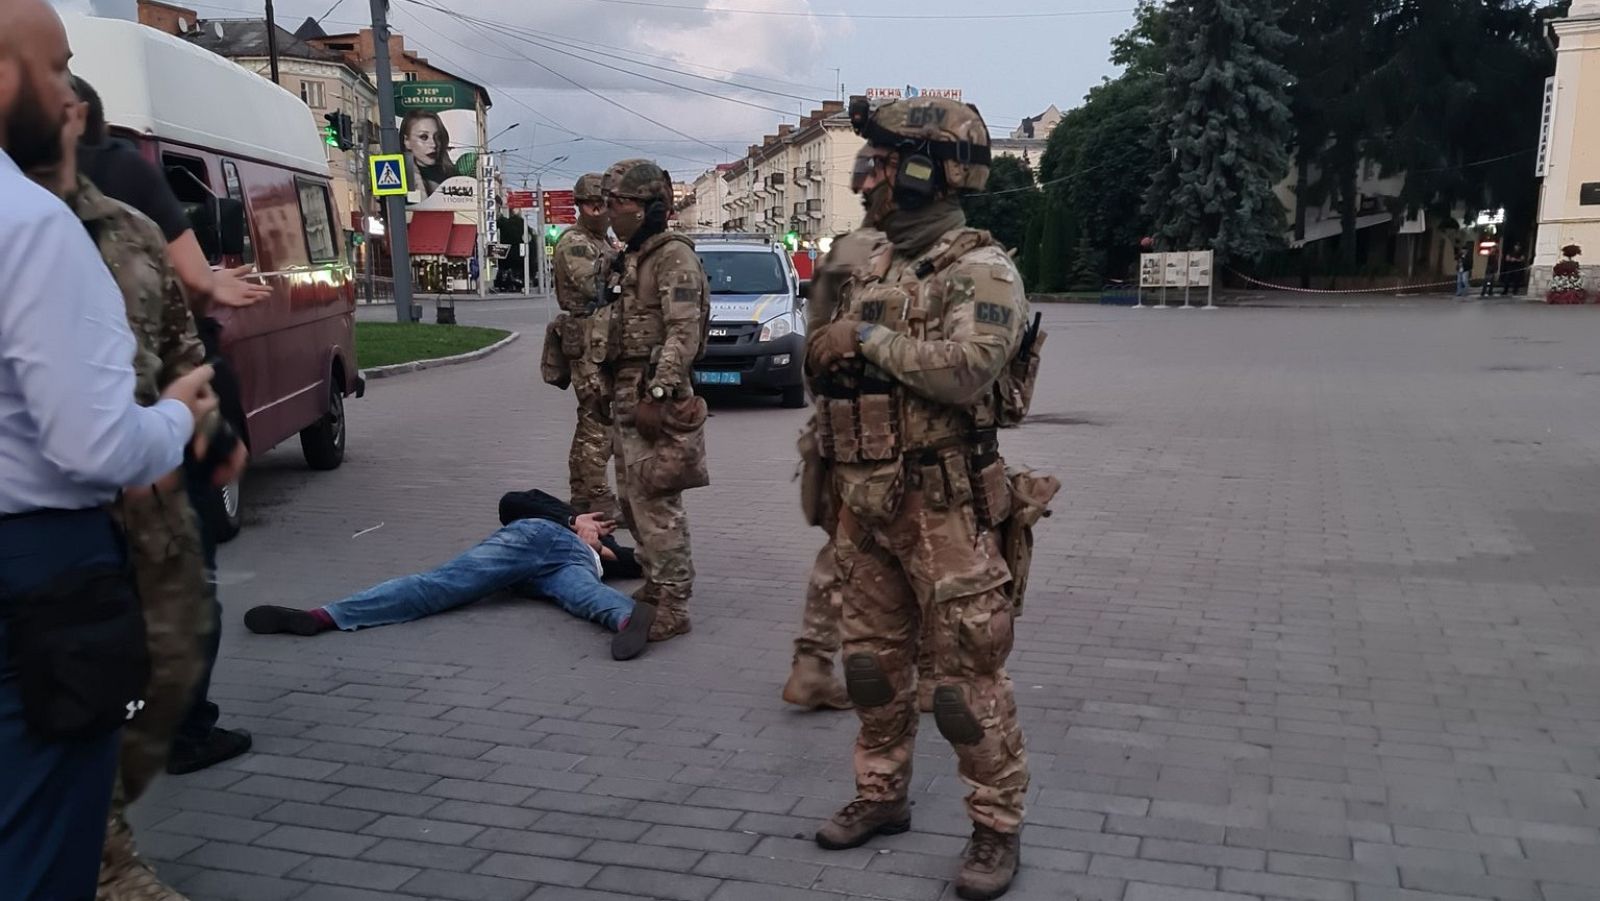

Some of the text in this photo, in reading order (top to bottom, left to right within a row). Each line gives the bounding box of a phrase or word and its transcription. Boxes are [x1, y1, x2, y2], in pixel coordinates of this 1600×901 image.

[404, 96, 453, 104] ЗОЛОТО
[416, 87, 440, 96] УКР
[909, 107, 946, 124] СБУ
[485, 156, 496, 242] ІНТЕРНЕТ
[862, 301, 885, 321] СБУ
[976, 302, 1012, 325] СБУ
